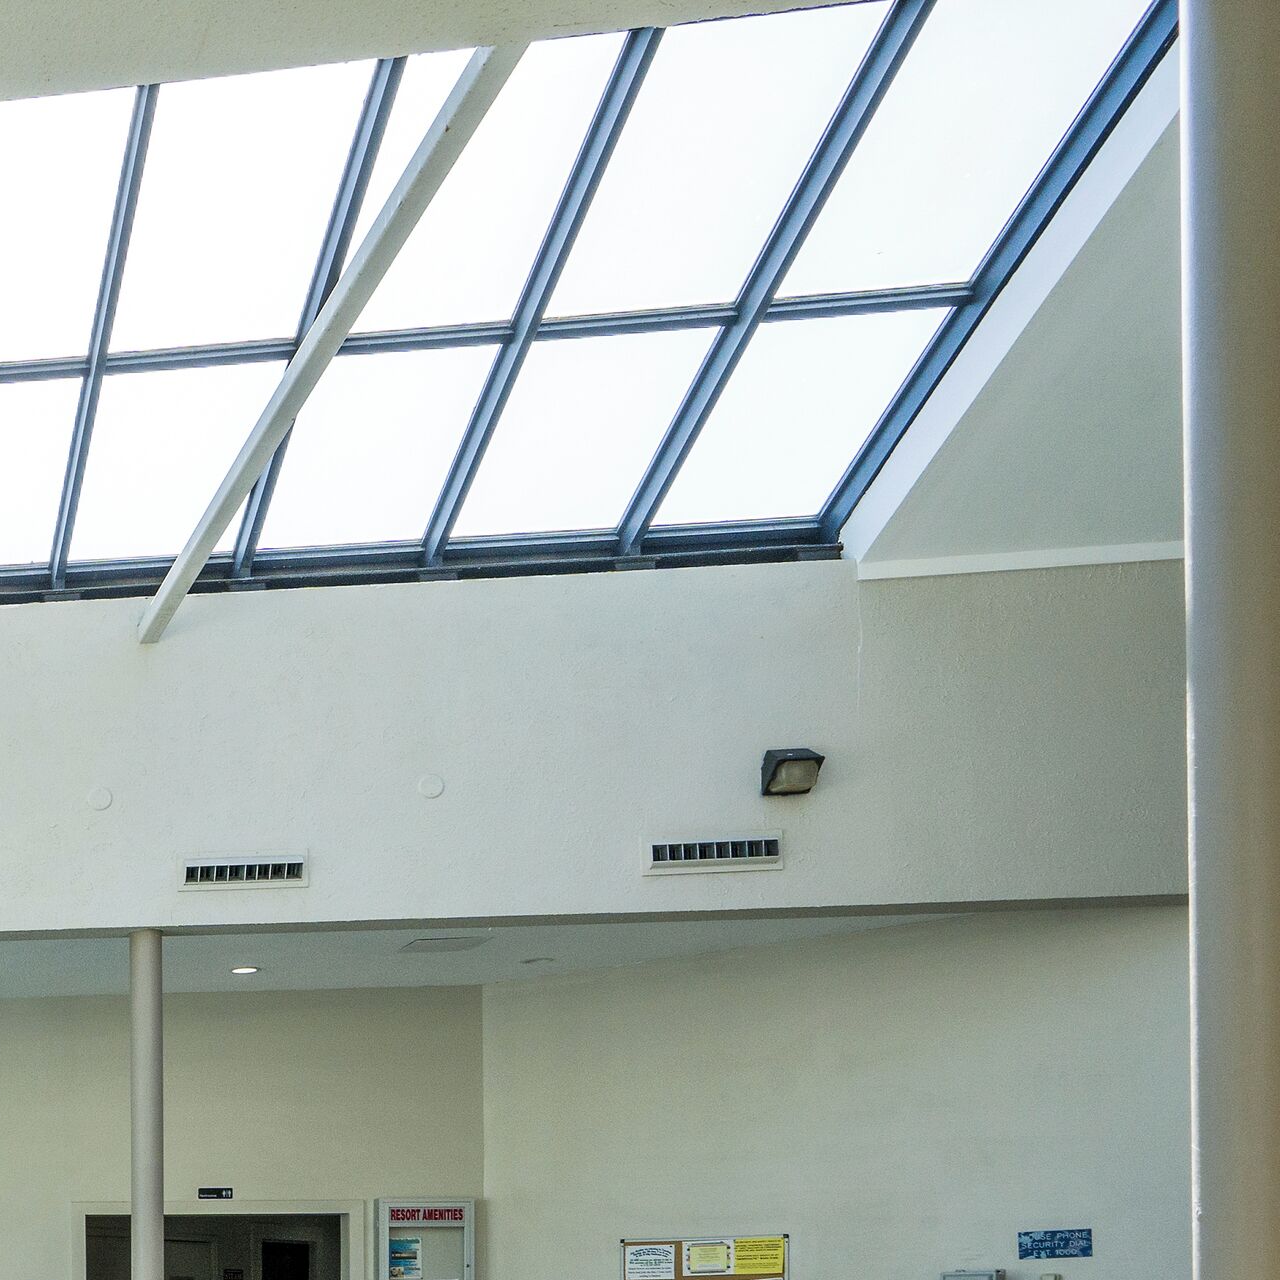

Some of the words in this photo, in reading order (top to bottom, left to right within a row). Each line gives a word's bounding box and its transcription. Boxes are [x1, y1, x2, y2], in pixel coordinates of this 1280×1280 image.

[390, 1208, 421, 1221] RESORT
[422, 1208, 464, 1221] AMENITIES
[1056, 1231, 1088, 1239] PHONE
[1021, 1240, 1065, 1249] SECURITY
[1069, 1239, 1089, 1248] DIAL
[1055, 1248, 1078, 1256] 1000
